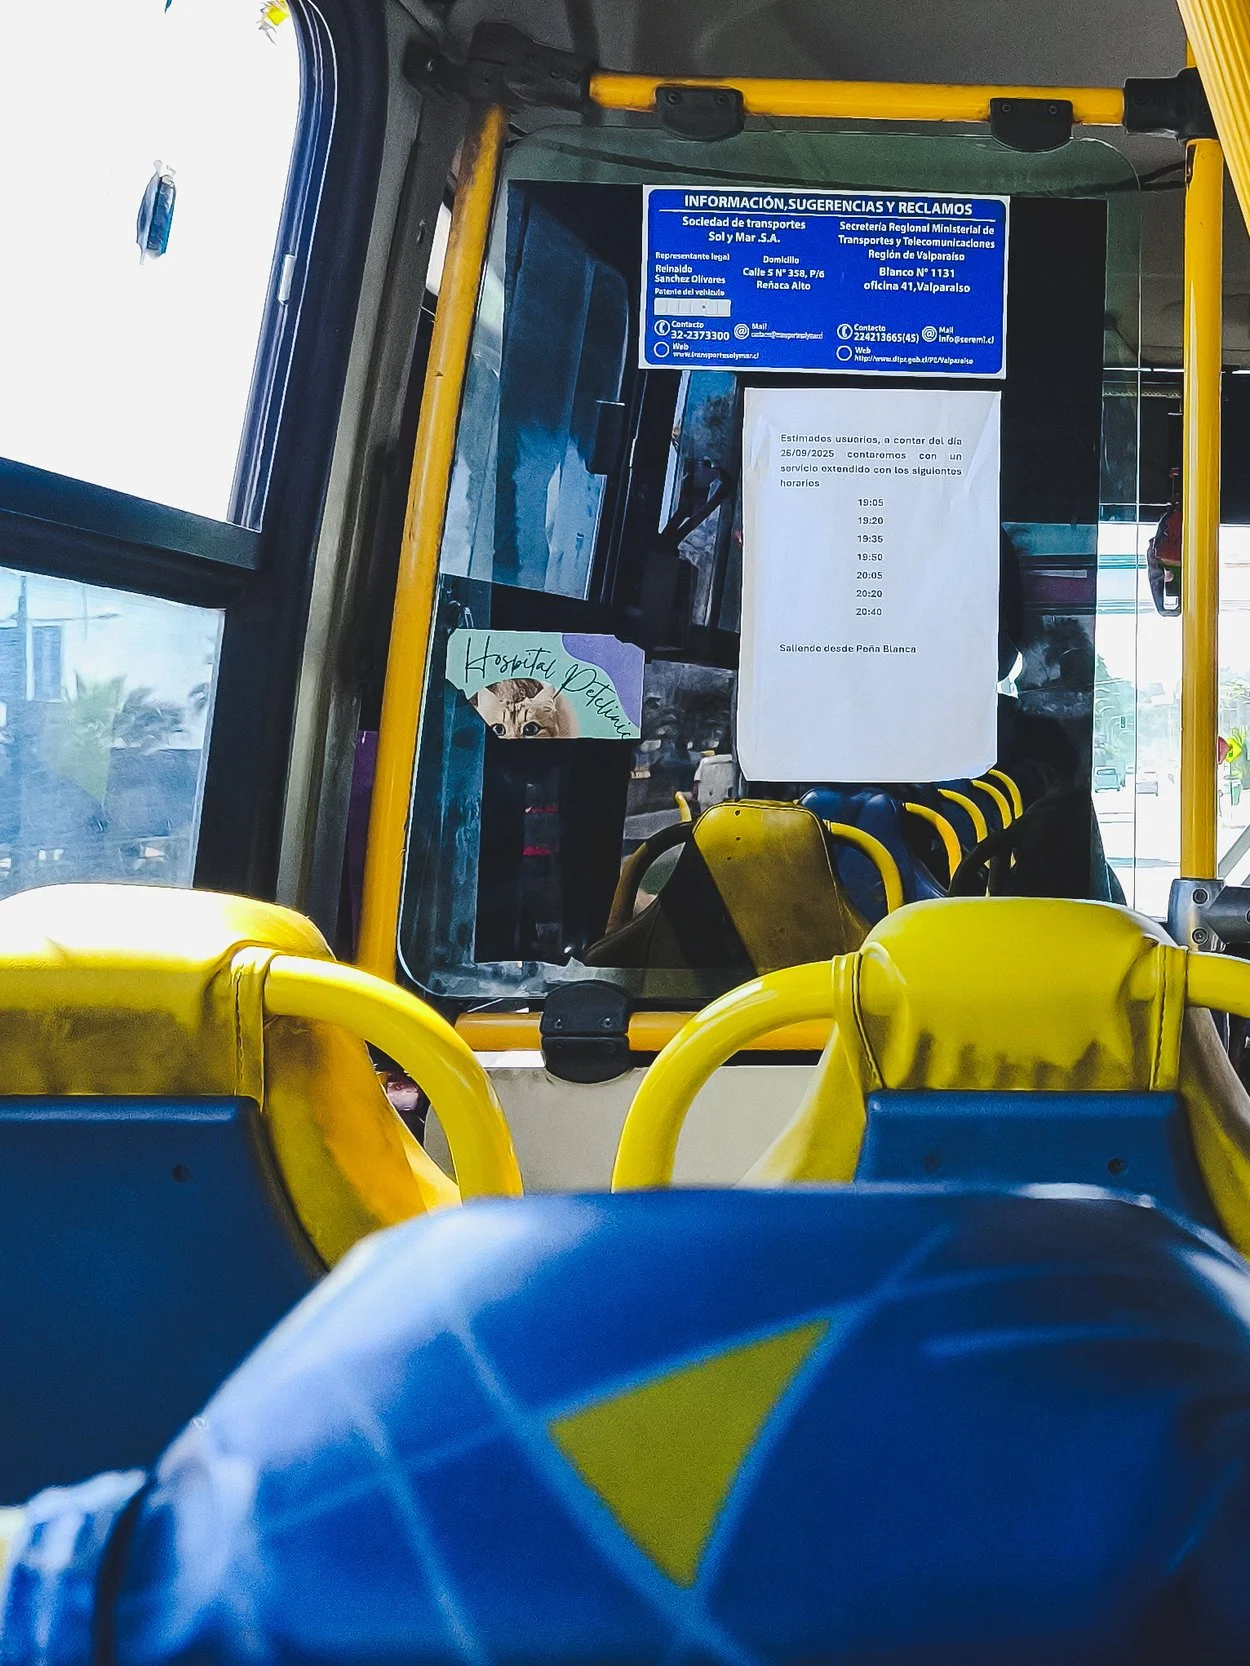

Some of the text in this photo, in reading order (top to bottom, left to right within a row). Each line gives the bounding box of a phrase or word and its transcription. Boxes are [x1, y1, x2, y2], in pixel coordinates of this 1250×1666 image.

[886, 202, 895, 213] Y
[898, 202, 973, 215] RECLAMOS
[682, 216, 806, 230] Sociedad de transportes
[889, 223, 930, 234] Regional
[932, 224, 980, 235] Ministerial
[982, 225, 994, 235] de
[708, 232, 725, 242] Sol
[726, 234, 732, 244] y
[735, 232, 756, 242] Mar
[838, 235, 995, 249] Transportes y Telecomunicaciones
[655, 252, 730, 262] Representante legal
[762, 256, 800, 264] Domicilio
[868, 250, 901, 260] Región
[903, 251, 914, 260] de
[655, 264, 692, 273] Reinaldo
[742, 268, 766, 277] Calle
[767, 268, 773, 277] 5
[879, 267, 914, 277] Blanco
[930, 268, 955, 278] 1131
[654, 274, 726, 284] Sanchez Olivares
[756, 280, 811, 290] Reñaca Alto
[864, 281, 898, 291] oficina
[654, 288, 682, 296] Patente
[683, 288, 694, 296] del
[672, 320, 704, 329] Contacto
[854, 324, 886, 332] Contacto
[938, 326, 954, 334] Mail
[670, 330, 730, 341] 32-2373300
[672, 342, 690, 350] Web
[854, 346, 872, 354] Web
[780, 434, 832, 443] Estimados
[836, 436, 881, 445] usuarios,
[893, 438, 926, 446] contar
[928, 437, 944, 446] del
[780, 449, 835, 458] 26/09/2025
[847, 452, 906, 460] contaremos
[918, 452, 937, 460] con
[780, 464, 818, 473] servicio
[821, 466, 870, 474] extendido
[894, 466, 909, 476] los
[912, 467, 962, 477] siguientes
[780, 478, 820, 488] horarios
[858, 499, 884, 507] 19:05
[858, 516, 884, 525] 19:20
[857, 535, 884, 544] 19:35
[857, 554, 883, 562] 19:50
[856, 572, 883, 580] 20:05
[856, 590, 883, 598] 20:20
[856, 608, 882, 616] 20:40
[780, 644, 916, 654] Saliendo desde Peña Blanca
[465, 635, 556, 683] Hospital
